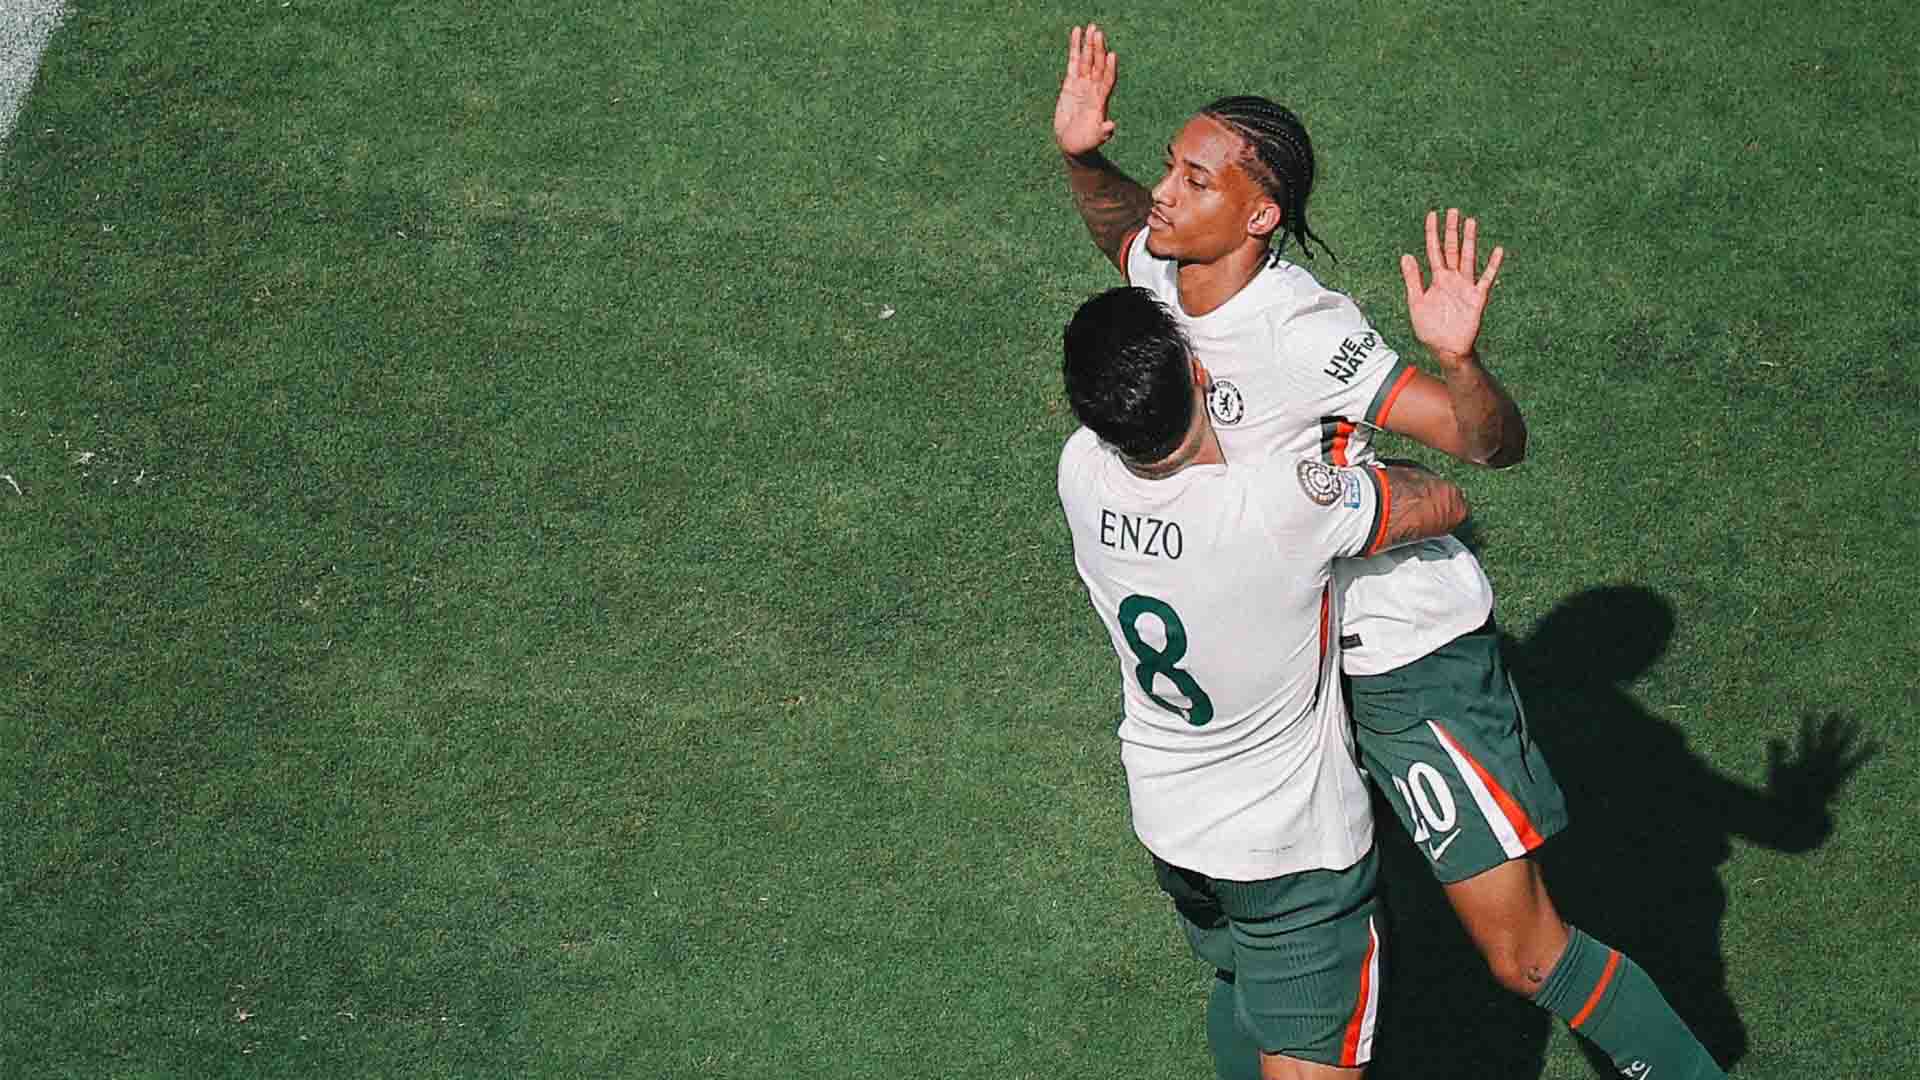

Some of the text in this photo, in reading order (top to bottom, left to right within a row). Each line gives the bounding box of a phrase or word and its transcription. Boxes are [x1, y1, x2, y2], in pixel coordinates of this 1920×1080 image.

[1323, 337, 1358, 378] LIVE
[1100, 508, 1183, 560] ENZO
[1117, 594, 1214, 726] 8
[1391, 762, 1456, 843] 20
